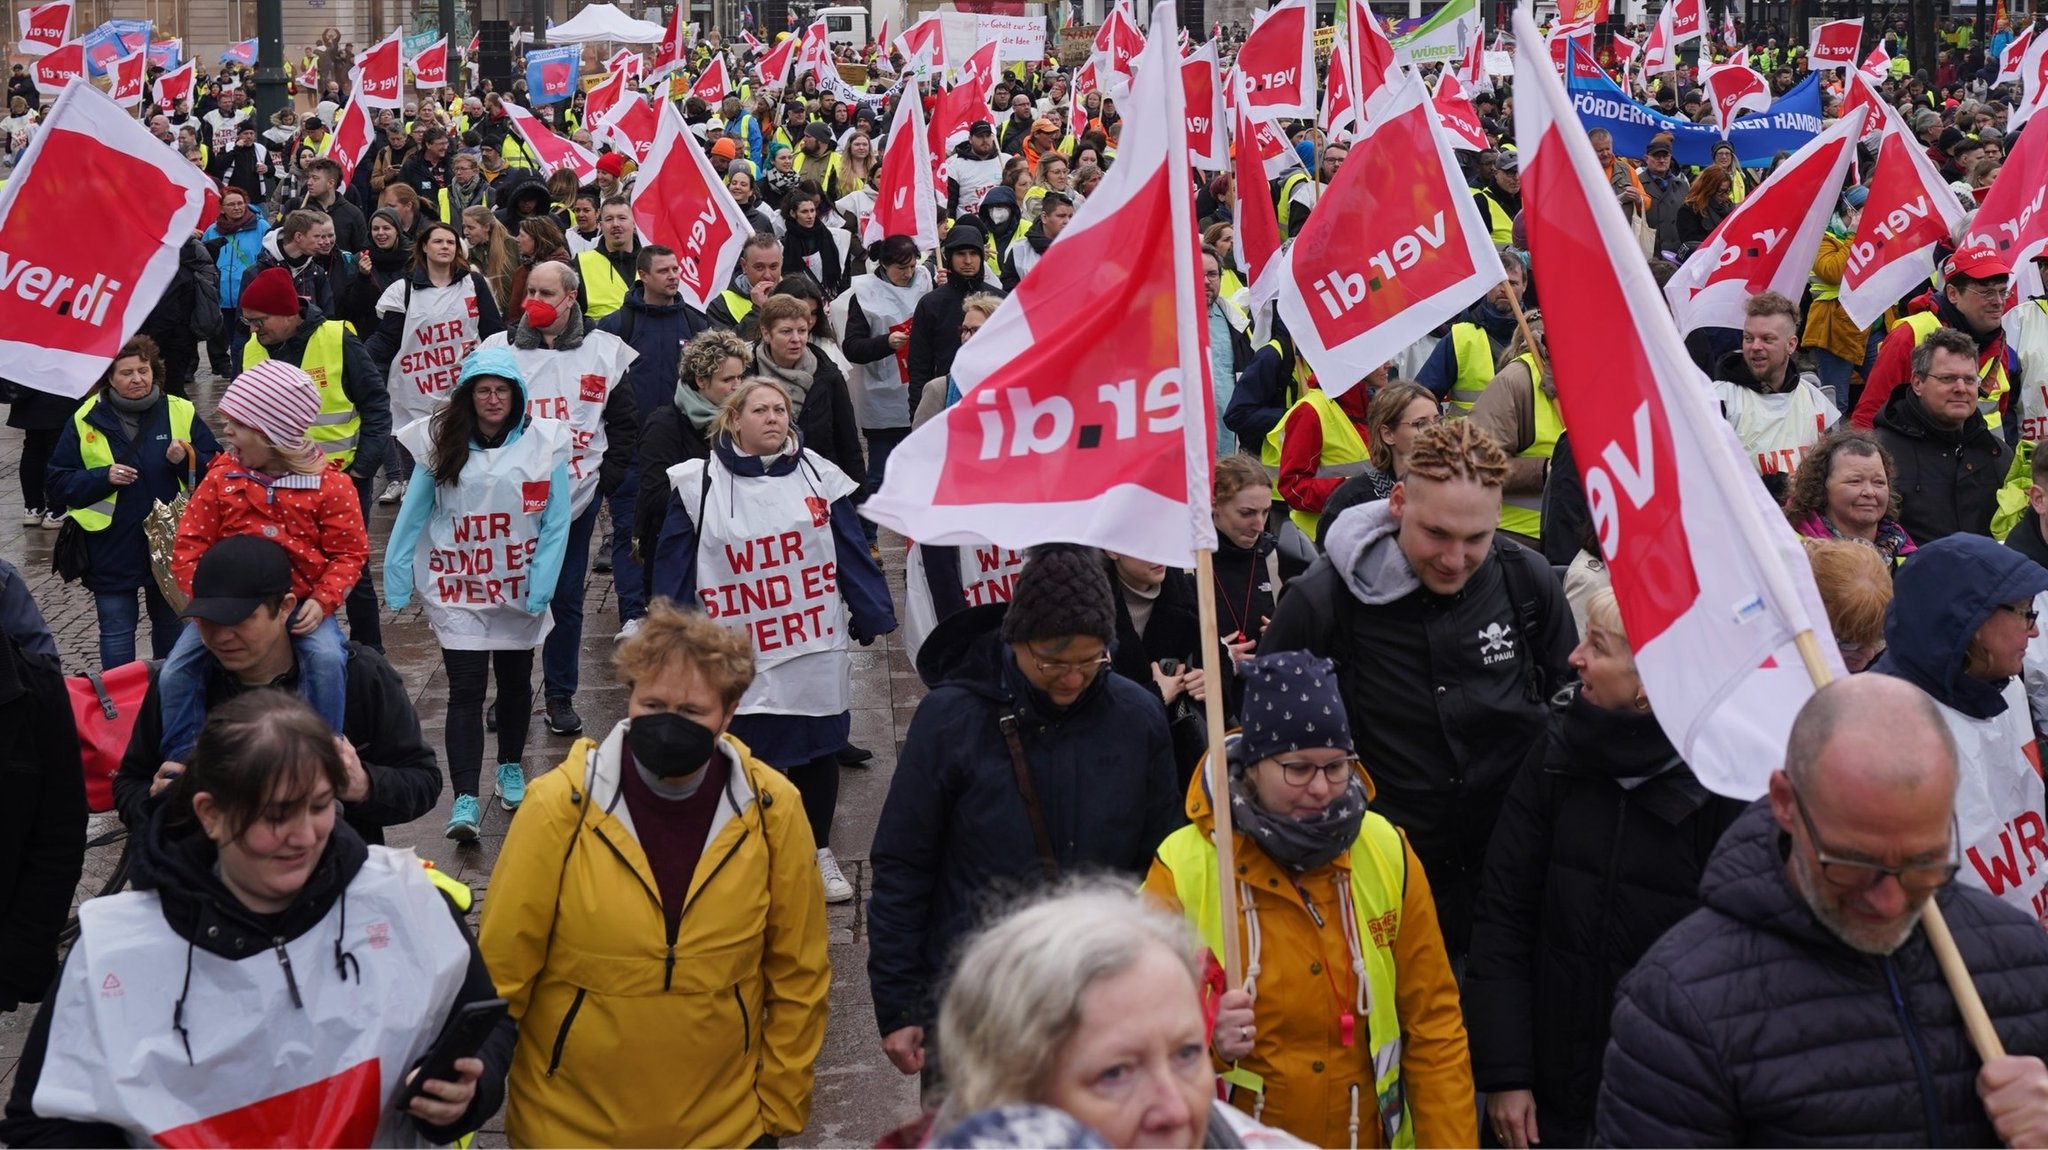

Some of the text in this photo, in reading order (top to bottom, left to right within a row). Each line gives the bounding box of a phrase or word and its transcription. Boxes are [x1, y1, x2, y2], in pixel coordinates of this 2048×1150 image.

[1411, 44, 1456, 58] WÜRDE
[1573, 92, 1654, 126] FÖRDERN
[0, 253, 121, 327] ver.di
[415, 320, 463, 345] WIR
[400, 345, 456, 374] SIND
[581, 389, 604, 400] ver.di
[524, 499, 547, 508] ver.d
[452, 512, 511, 544] WIR
[429, 547, 493, 576] SIND
[725, 530, 804, 575] WIR
[437, 575, 530, 604] WERT.
[698, 561, 837, 620] SIND ES
[745, 605, 834, 652] ERT.
[1483, 650, 1515, 665] ST. PAULI
